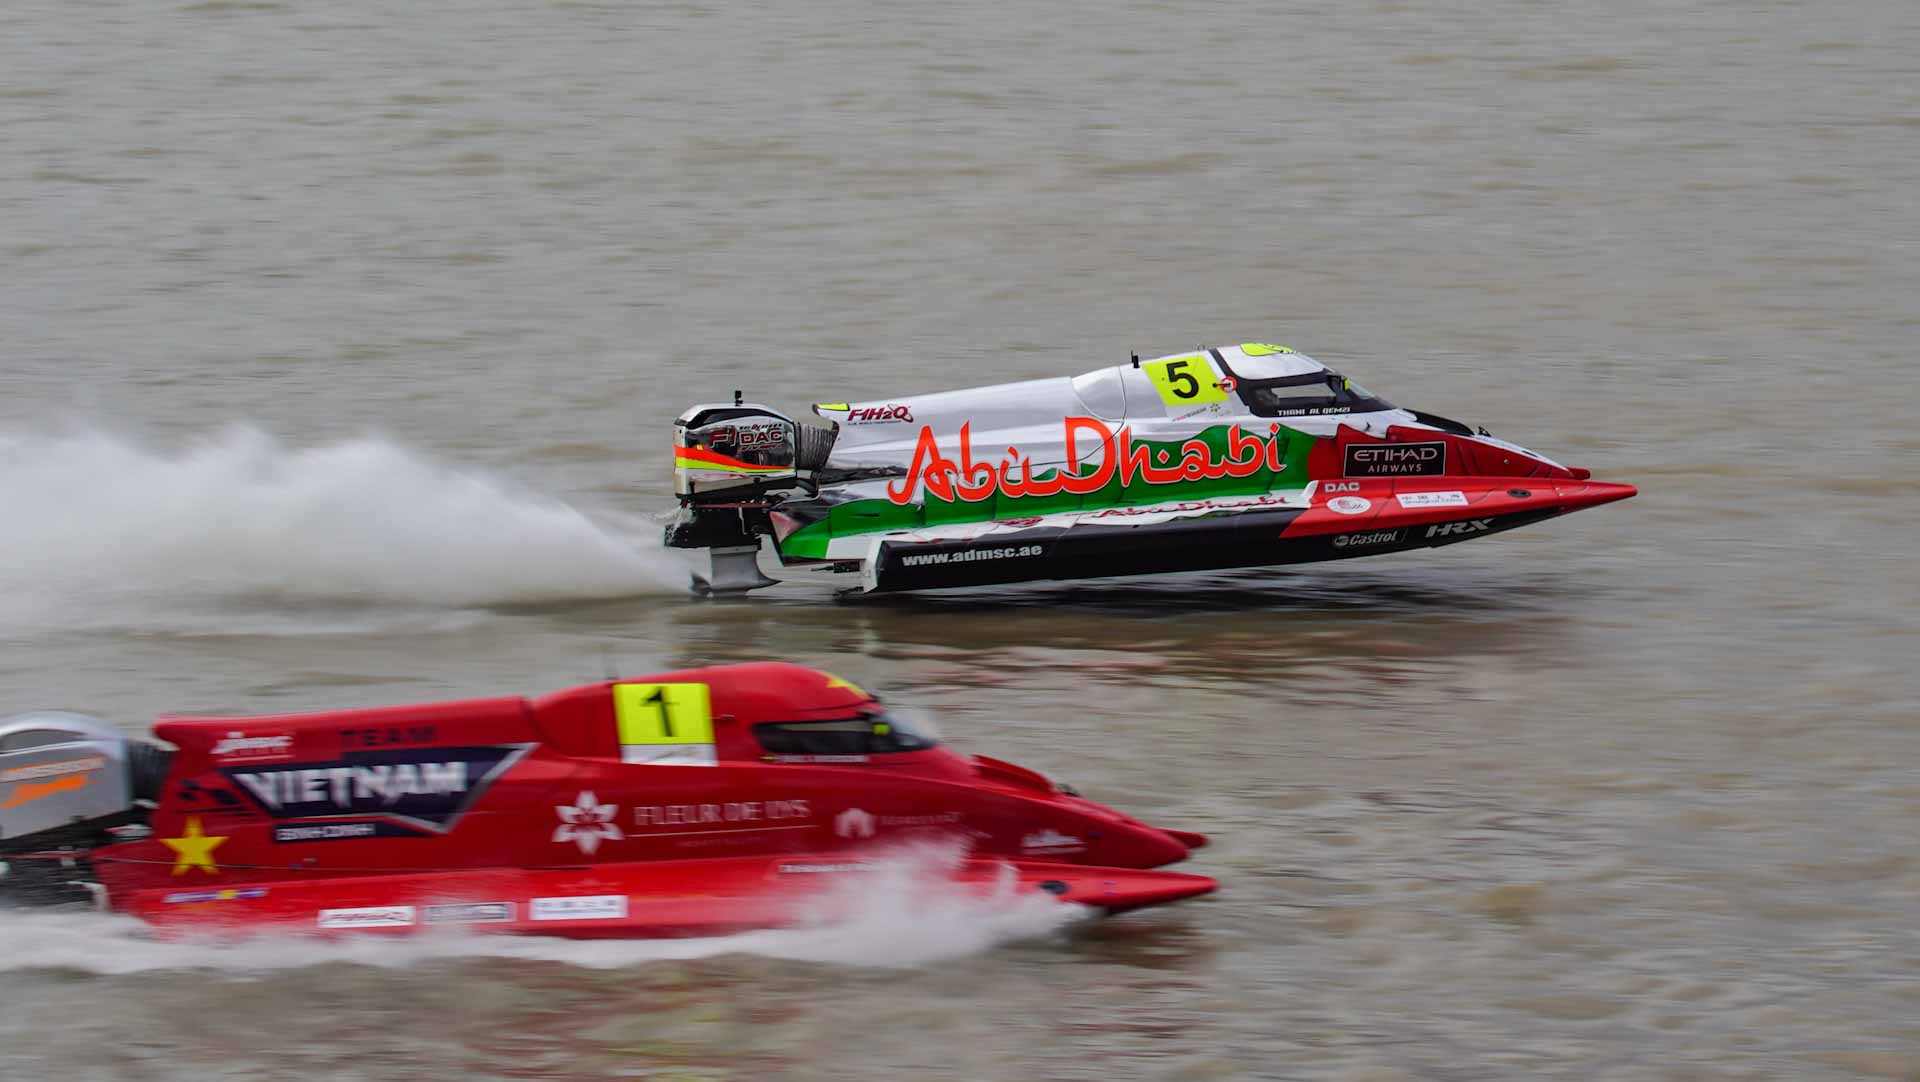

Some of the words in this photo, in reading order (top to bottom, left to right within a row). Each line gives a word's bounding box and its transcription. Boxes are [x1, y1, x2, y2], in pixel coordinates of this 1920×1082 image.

[1166, 361, 1200, 399] 5
[739, 429, 784, 446] DAC
[887, 420, 1064, 504] Abu
[1064, 415, 1288, 494] Dhabi
[1353, 447, 1438, 462] ETIHAD
[1367, 464, 1422, 473] AIRWAYS
[1324, 482, 1360, 493] DAC
[1349, 530, 1398, 546] Castrol
[1425, 518, 1495, 539] HRX
[901, 544, 1043, 567] www.admsc.ae
[641, 684, 678, 738] 1
[336, 725, 438, 747] TEAM
[231, 761, 469, 811] VIETNAM
[633, 803, 722, 826] FLEUR
[723, 801, 763, 822] DE
[764, 799, 812, 820] LYS
